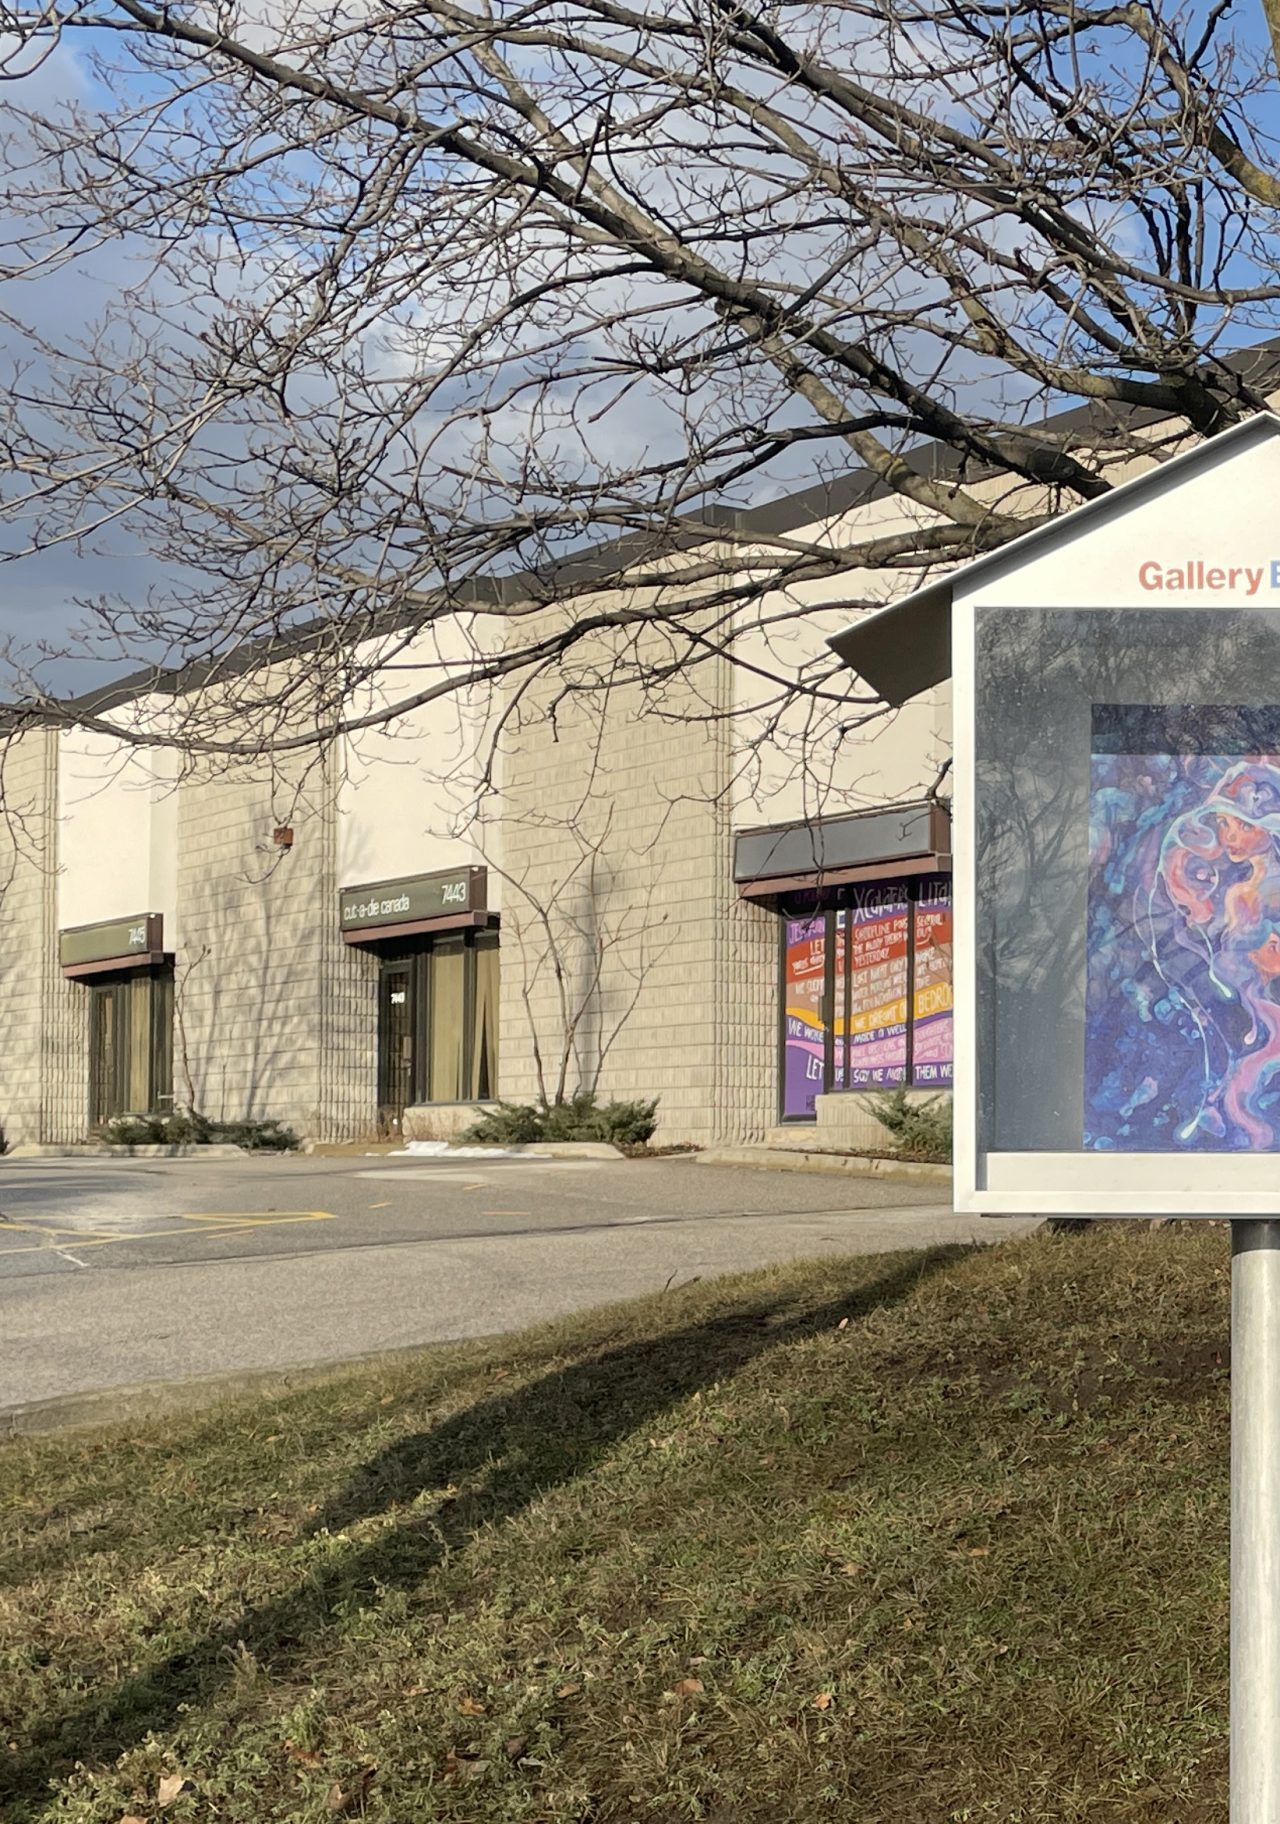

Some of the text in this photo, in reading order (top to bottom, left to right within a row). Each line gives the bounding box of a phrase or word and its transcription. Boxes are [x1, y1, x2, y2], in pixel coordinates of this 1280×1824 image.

[380, 893, 410, 914] canada
[441, 882, 466, 904] 7443
[788, 1018, 802, 1038] WE
[806, 1053, 825, 1081] LET
[872, 1068, 884, 1082] WE
[914, 1064, 938, 1081] THEM
